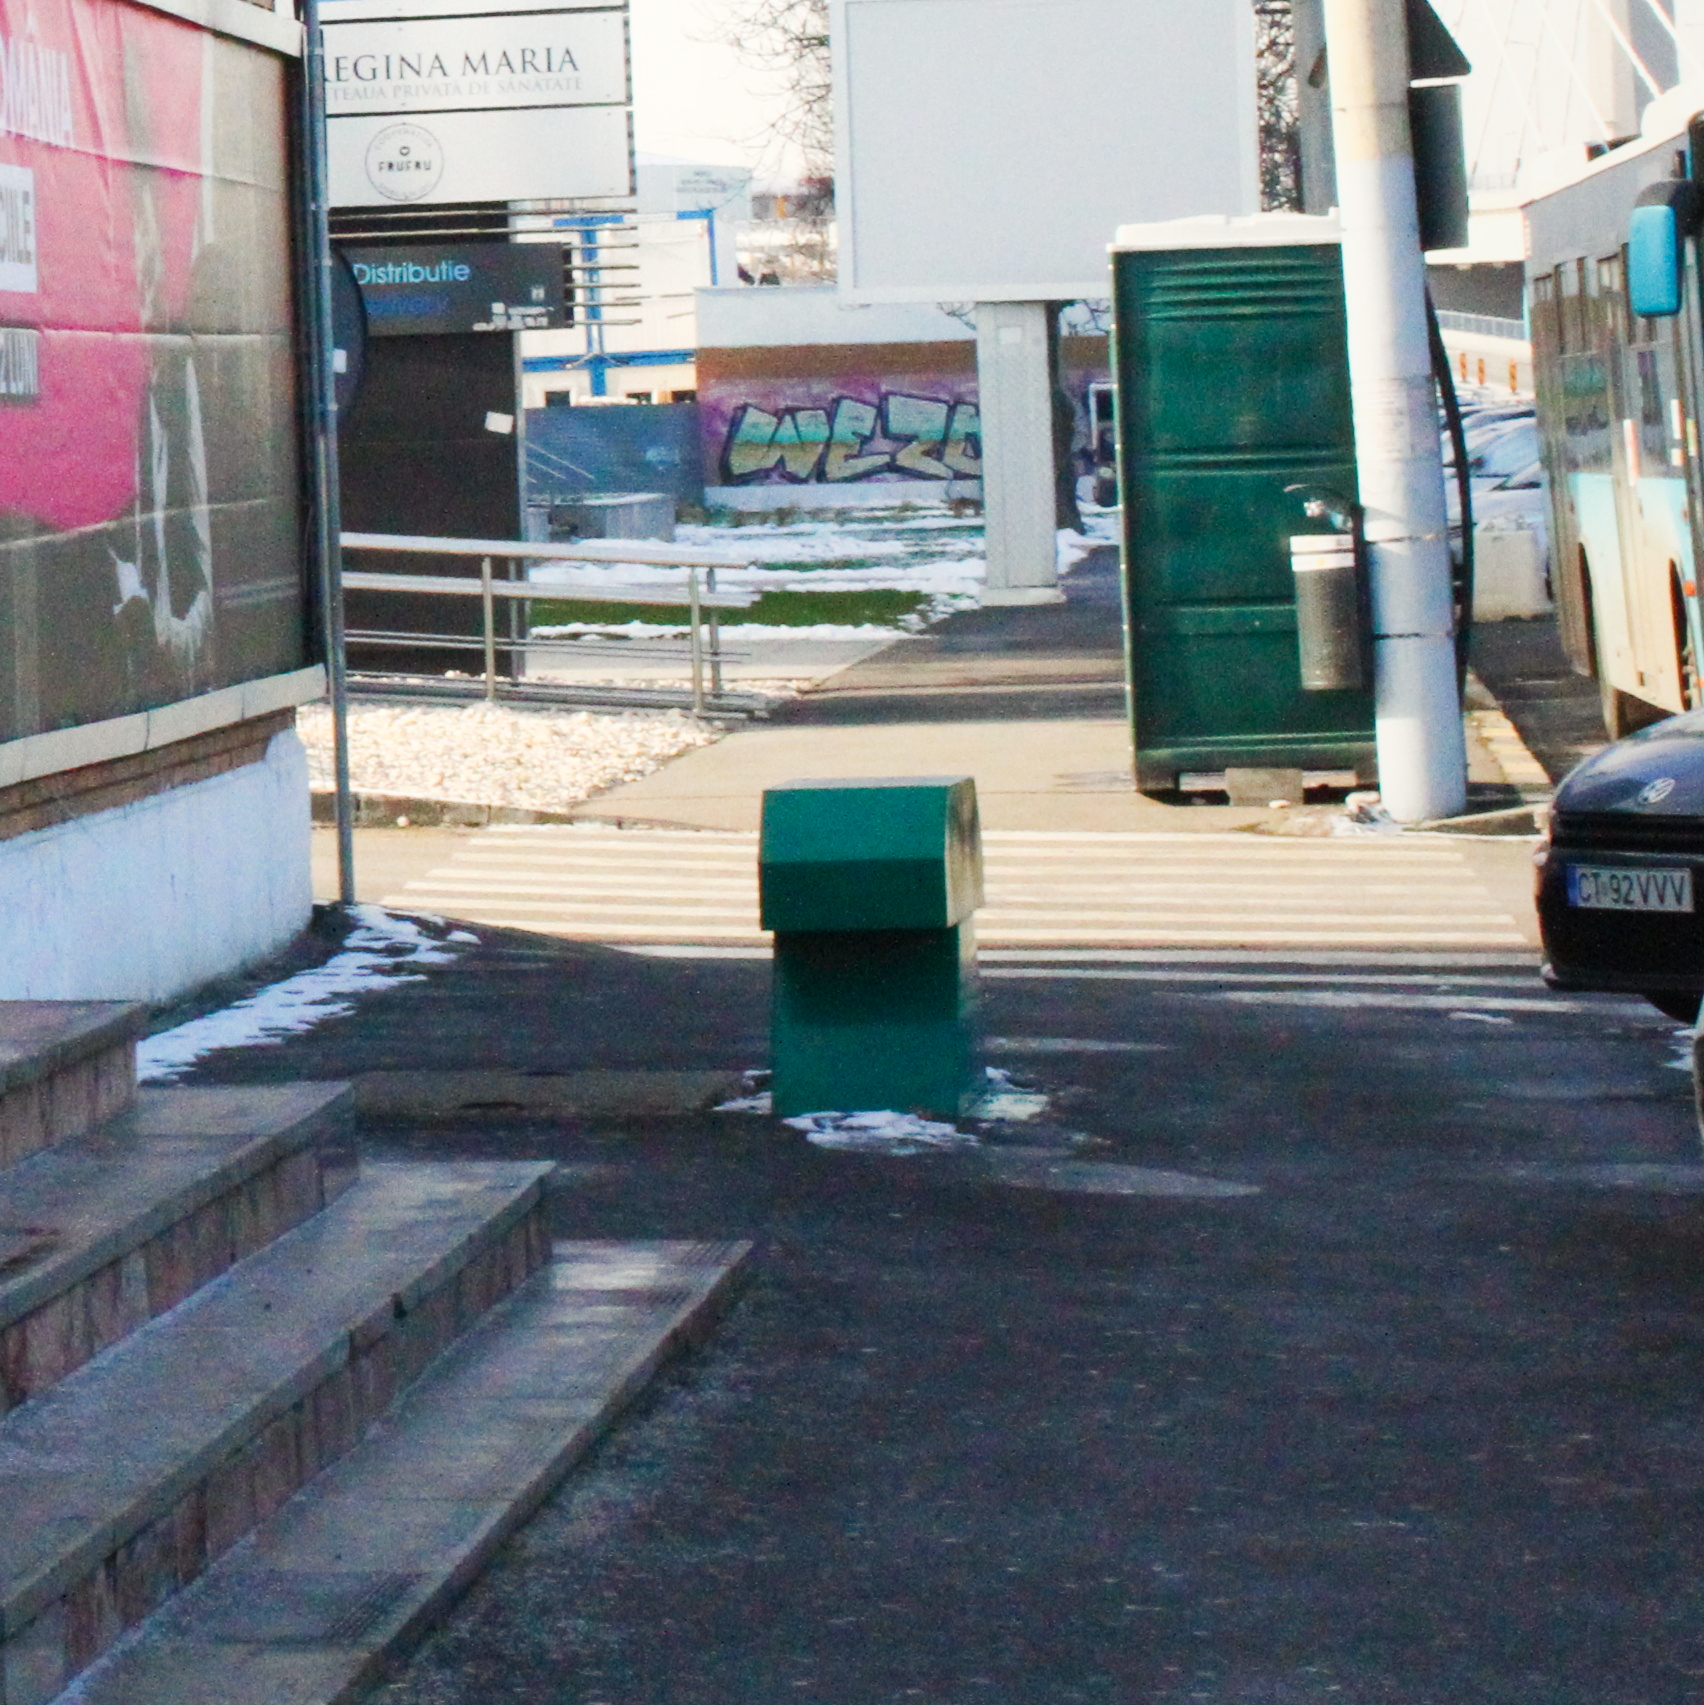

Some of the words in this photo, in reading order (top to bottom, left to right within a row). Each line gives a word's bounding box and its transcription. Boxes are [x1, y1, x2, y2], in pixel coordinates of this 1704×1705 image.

[323, 53, 449, 83] EGINA
[462, 47, 580, 76] MARIA
[468, 81, 491, 95] DE
[1577, 871, 1602, 904] CT
